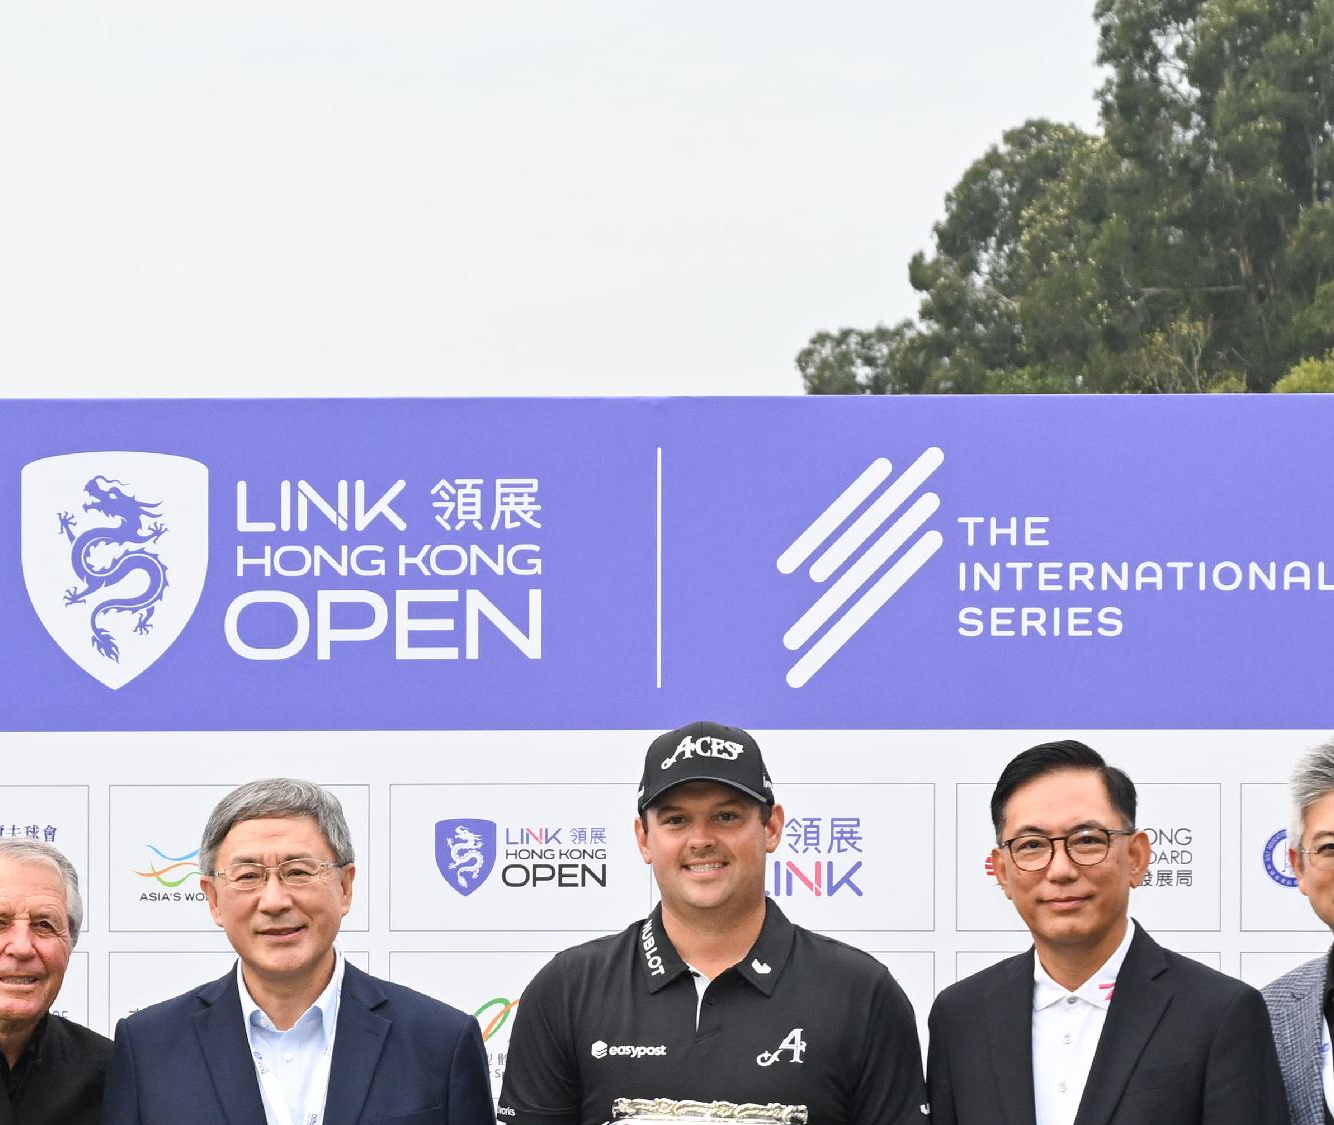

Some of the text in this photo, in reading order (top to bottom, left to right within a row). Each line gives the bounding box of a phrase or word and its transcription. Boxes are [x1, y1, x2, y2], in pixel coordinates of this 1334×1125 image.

[237, 479, 541, 531] LINK 領展
[958, 517, 1049, 545] THE
[237, 545, 541, 576] HONG KONG
[225, 589, 541, 660] OPEN
[959, 607, 1122, 636] SERIES
[506, 828, 606, 845] LINK 領展
[785, 817, 863, 853] 領展
[1149, 828, 1192, 846] ONG
[506, 849, 606, 859] HONG KONG
[502, 864, 606, 887] OPEN
[770, 861, 863, 897] INK
[139, 892, 182, 902] ASIA'S
[641, 919, 665, 976] HUBLOT
[608, 1043, 667, 1059] easypost
